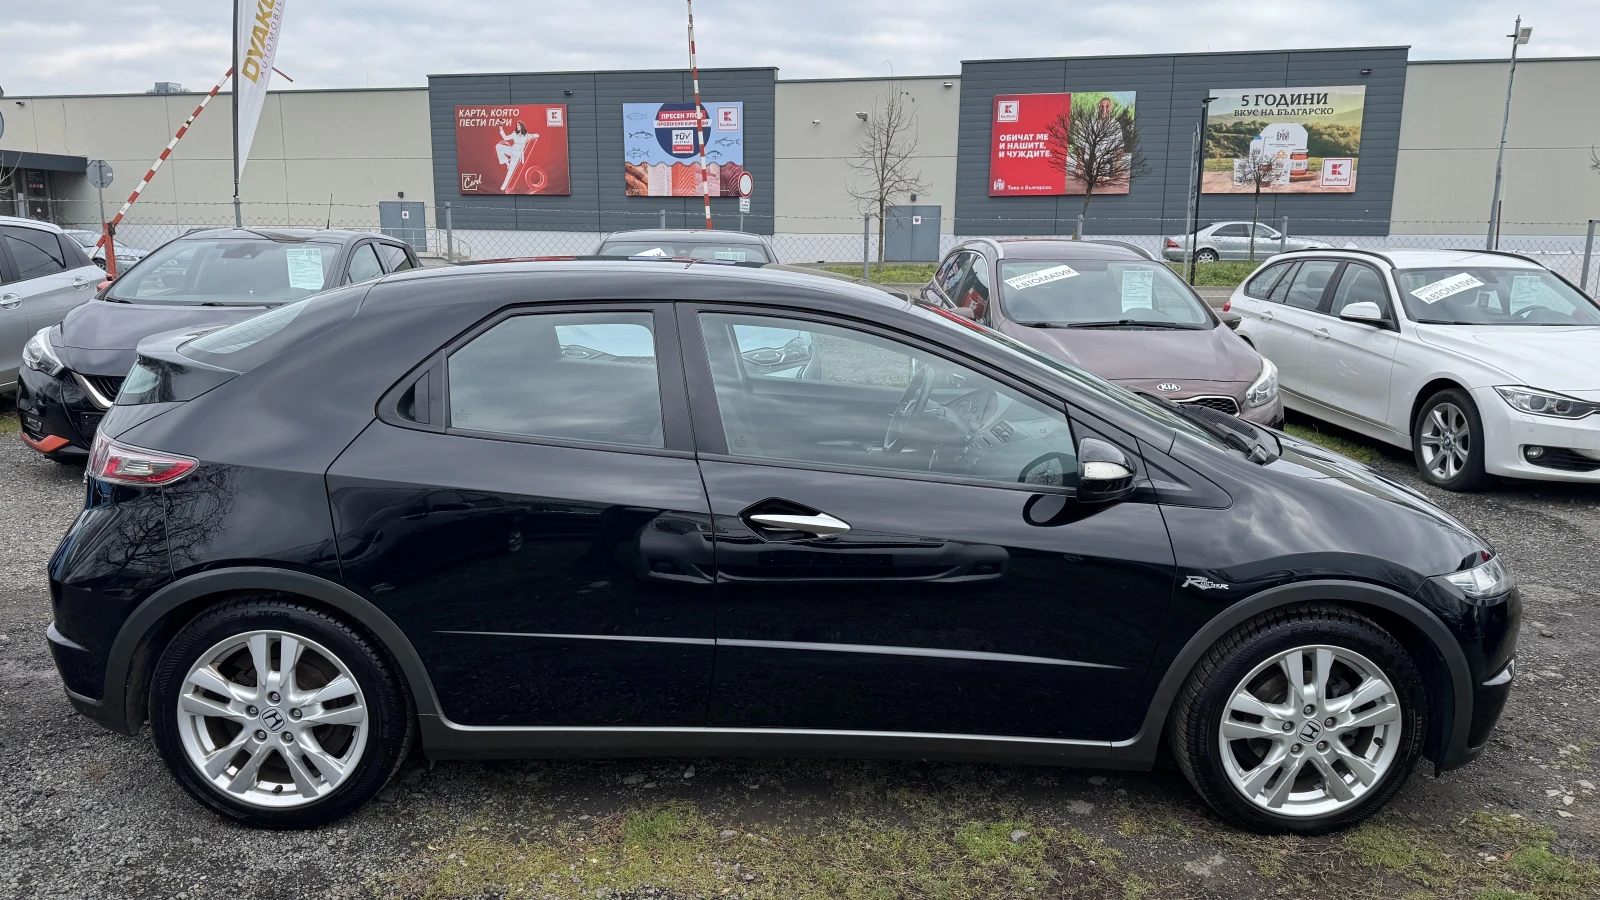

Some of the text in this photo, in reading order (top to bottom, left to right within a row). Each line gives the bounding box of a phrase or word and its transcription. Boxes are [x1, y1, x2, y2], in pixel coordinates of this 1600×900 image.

[1241, 93, 1329, 107] 5 ГОДИНИ
[459, 108, 520, 118] КАРТА, КОЯТО
[1234, 109, 1259, 117] ВКУС
[1276, 107, 1334, 116] БЪЛГАРСКО
[459, 119, 487, 127] ПЕСТИ
[1035, 133, 1049, 141] МЕ
[1006, 141, 1047, 150] НАШИТЕ,
[1015, 268, 1075, 290] АВТОМАТИК
[1424, 277, 1480, 303] АВТОМАТИК
